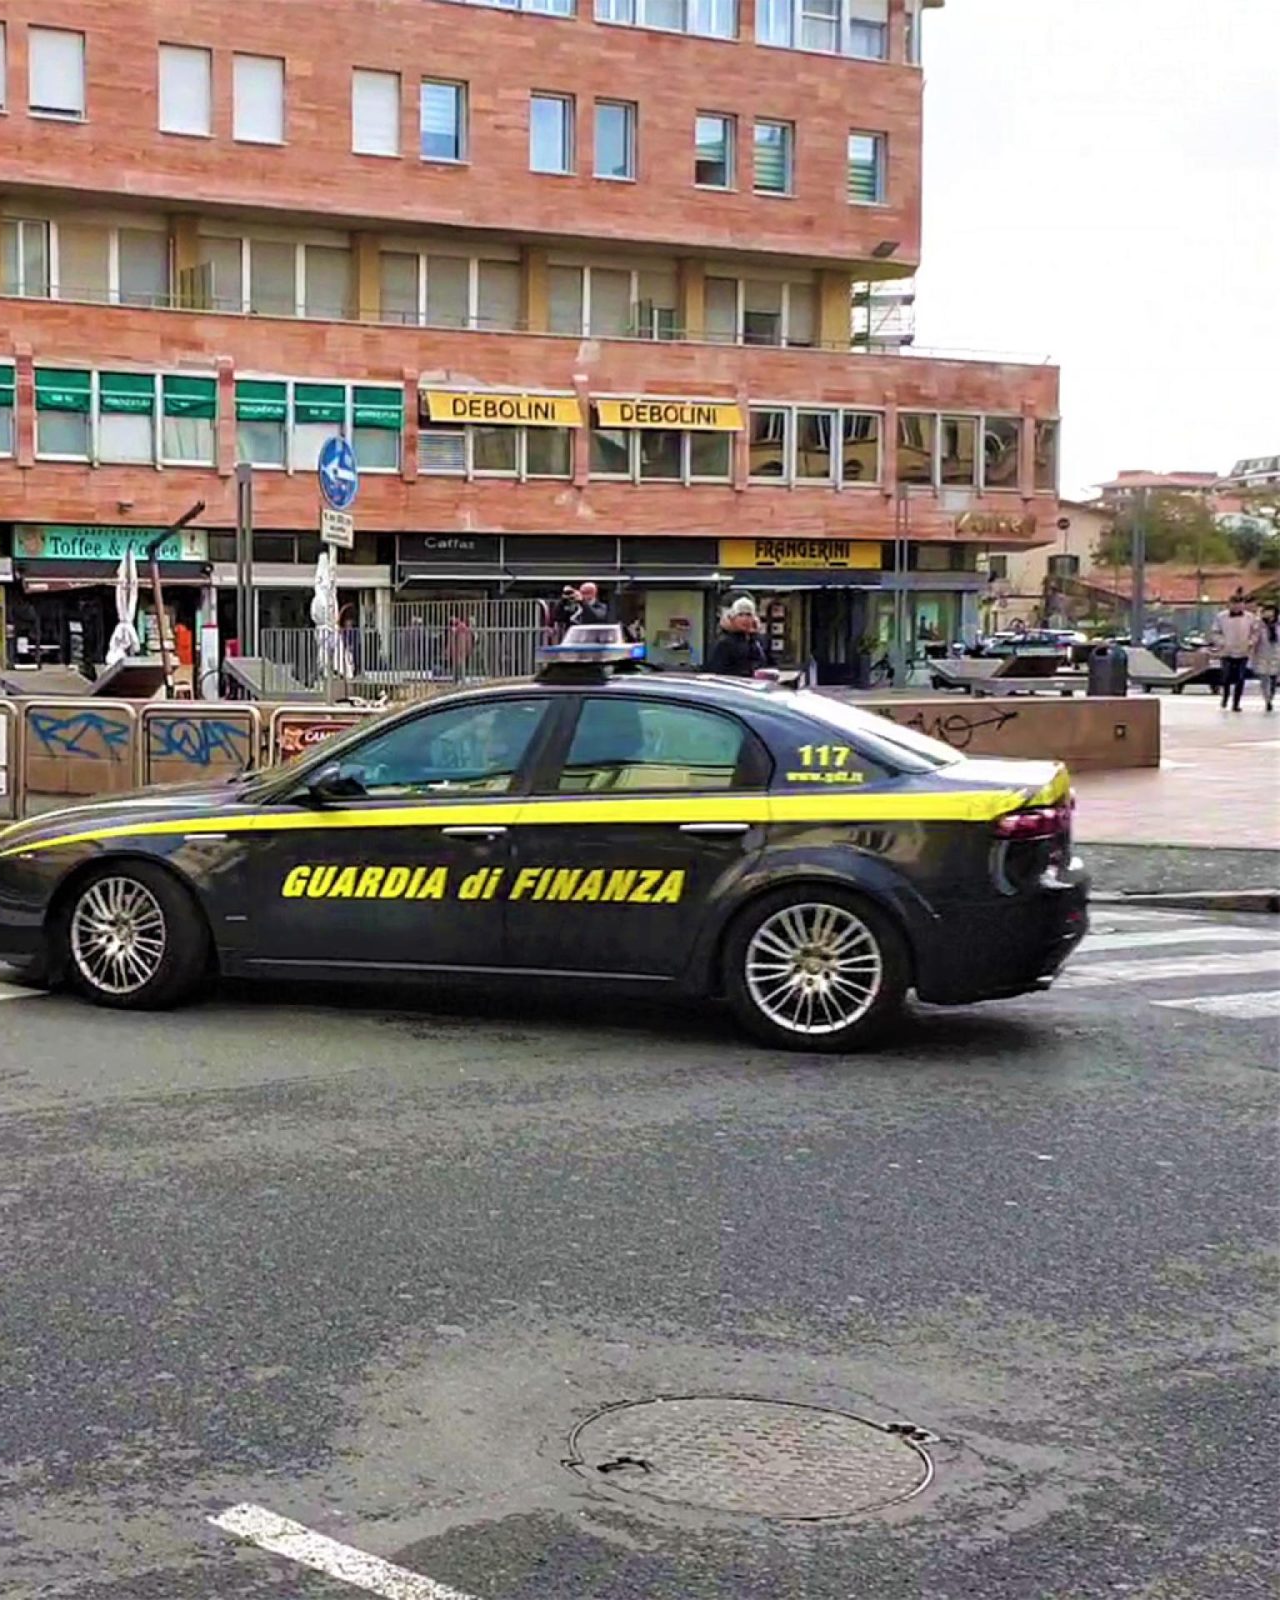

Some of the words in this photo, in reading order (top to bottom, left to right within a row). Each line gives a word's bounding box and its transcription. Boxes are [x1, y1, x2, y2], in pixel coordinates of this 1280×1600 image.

[452, 398, 556, 421] DEBOLINI
[620, 404, 718, 425] DEBOLINI
[49, 536, 102, 557] Toffee
[109, 539, 121, 556] &
[755, 541, 850, 563] FRANGERINI
[798, 744, 850, 767] 117
[282, 865, 449, 899] GUARDIA
[458, 867, 505, 900] di
[508, 868, 687, 904] FINANZA
